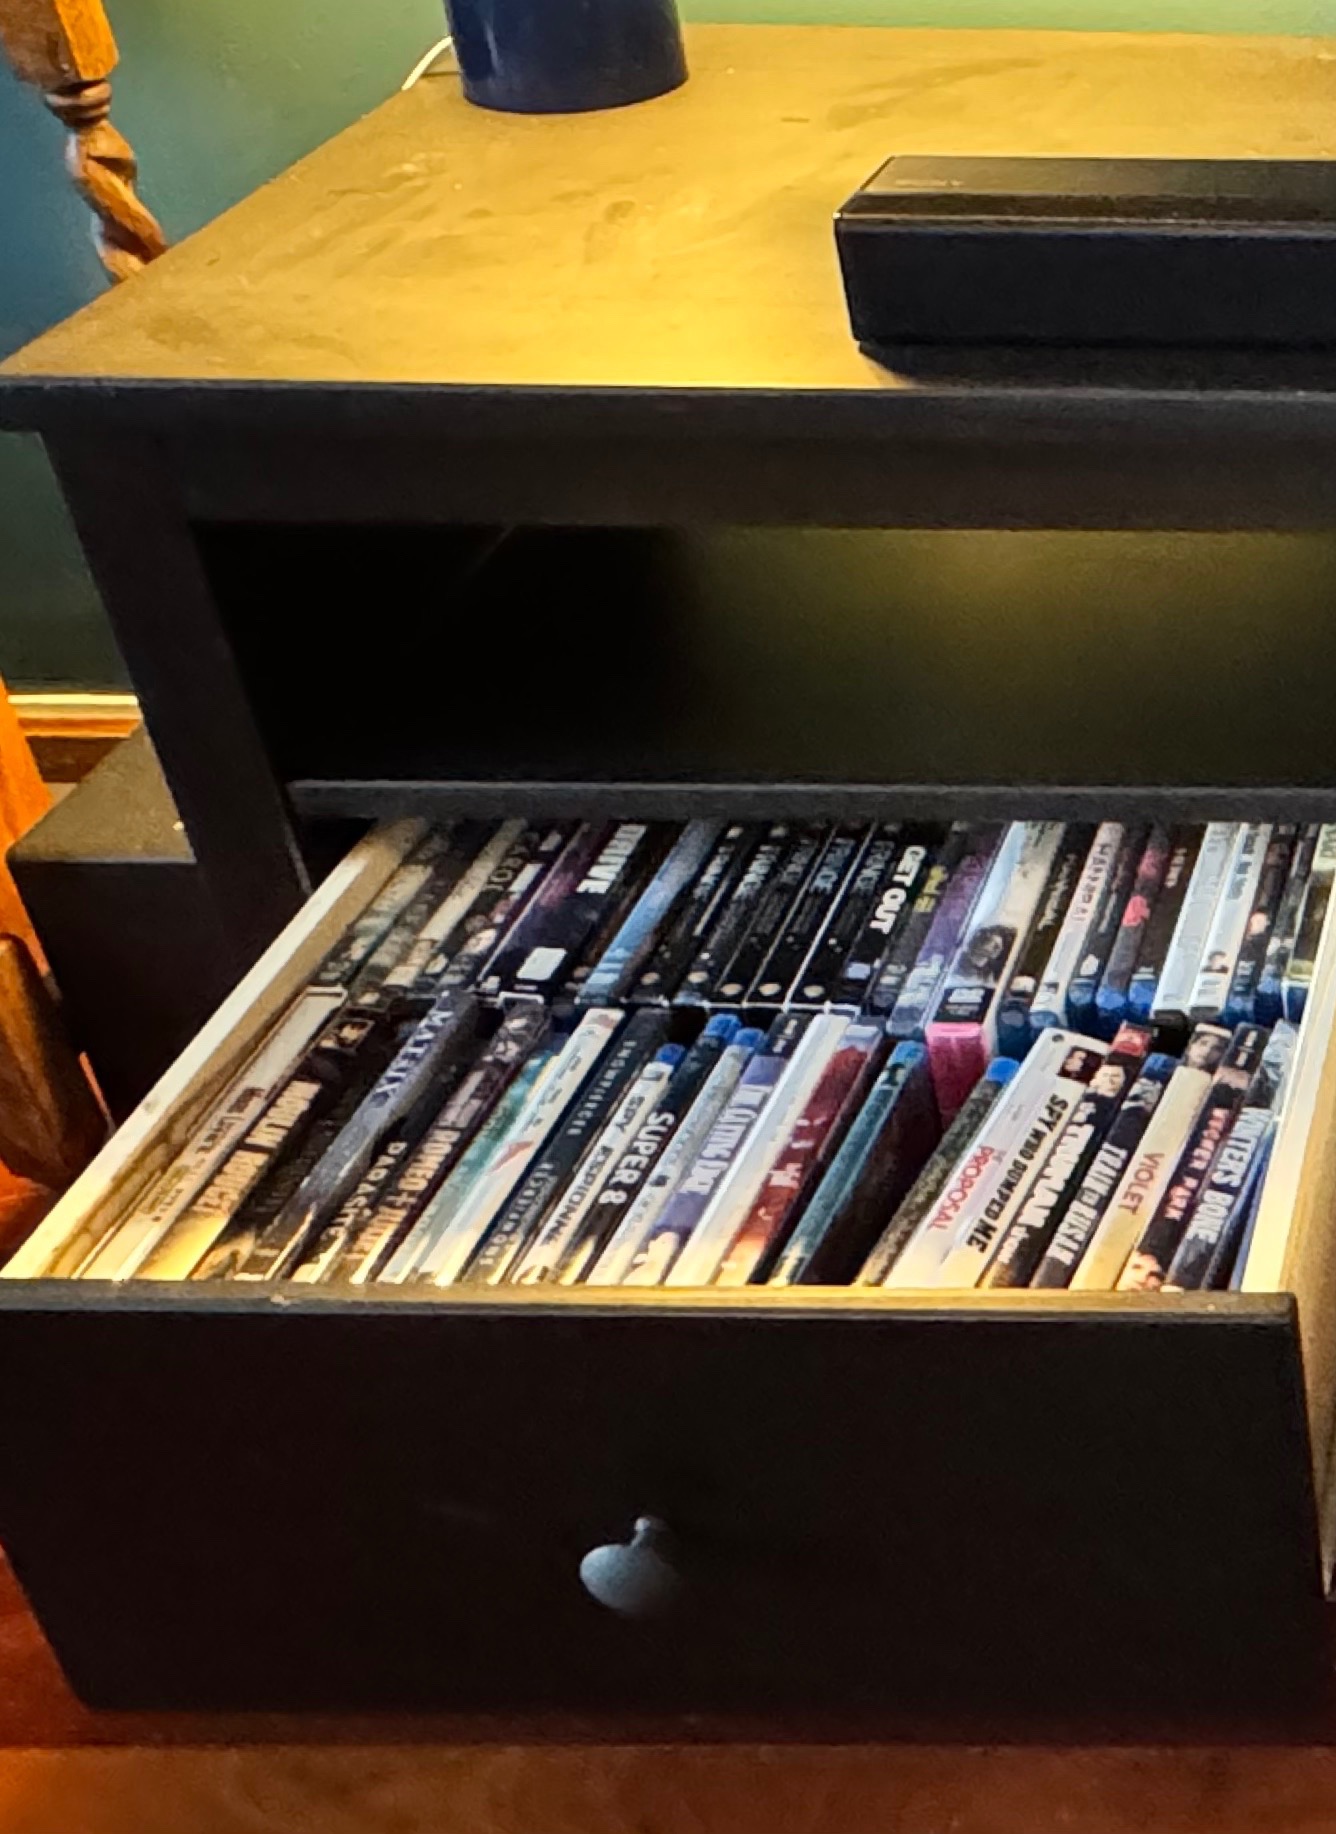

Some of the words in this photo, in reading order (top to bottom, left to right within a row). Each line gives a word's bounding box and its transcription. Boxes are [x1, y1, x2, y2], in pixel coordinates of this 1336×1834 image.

[893, 845, 928, 887] GET
[870, 887, 907, 935] OUT
[618, 1095, 645, 1132] SPY
[1043, 1093, 1069, 1133] SPY
[397, 1128, 460, 1192] ROMEO
[609, 1110, 675, 1187] SUPER
[1019, 1128, 1046, 1161] WHO
[1081, 1142, 1127, 1196] TRAIN
[598, 1188, 628, 1205] 8
[928, 1145, 994, 1229] PROPOSAL
[984, 1157, 1028, 1222] DUMPED
[1117, 1152, 1165, 1215] VIOLET
[1164, 1175, 1198, 1221] PARK
[967, 1222, 999, 1253] ME
[1048, 1199, 1098, 1266] BUSAN
[1186, 1189, 1234, 1244] BONE
